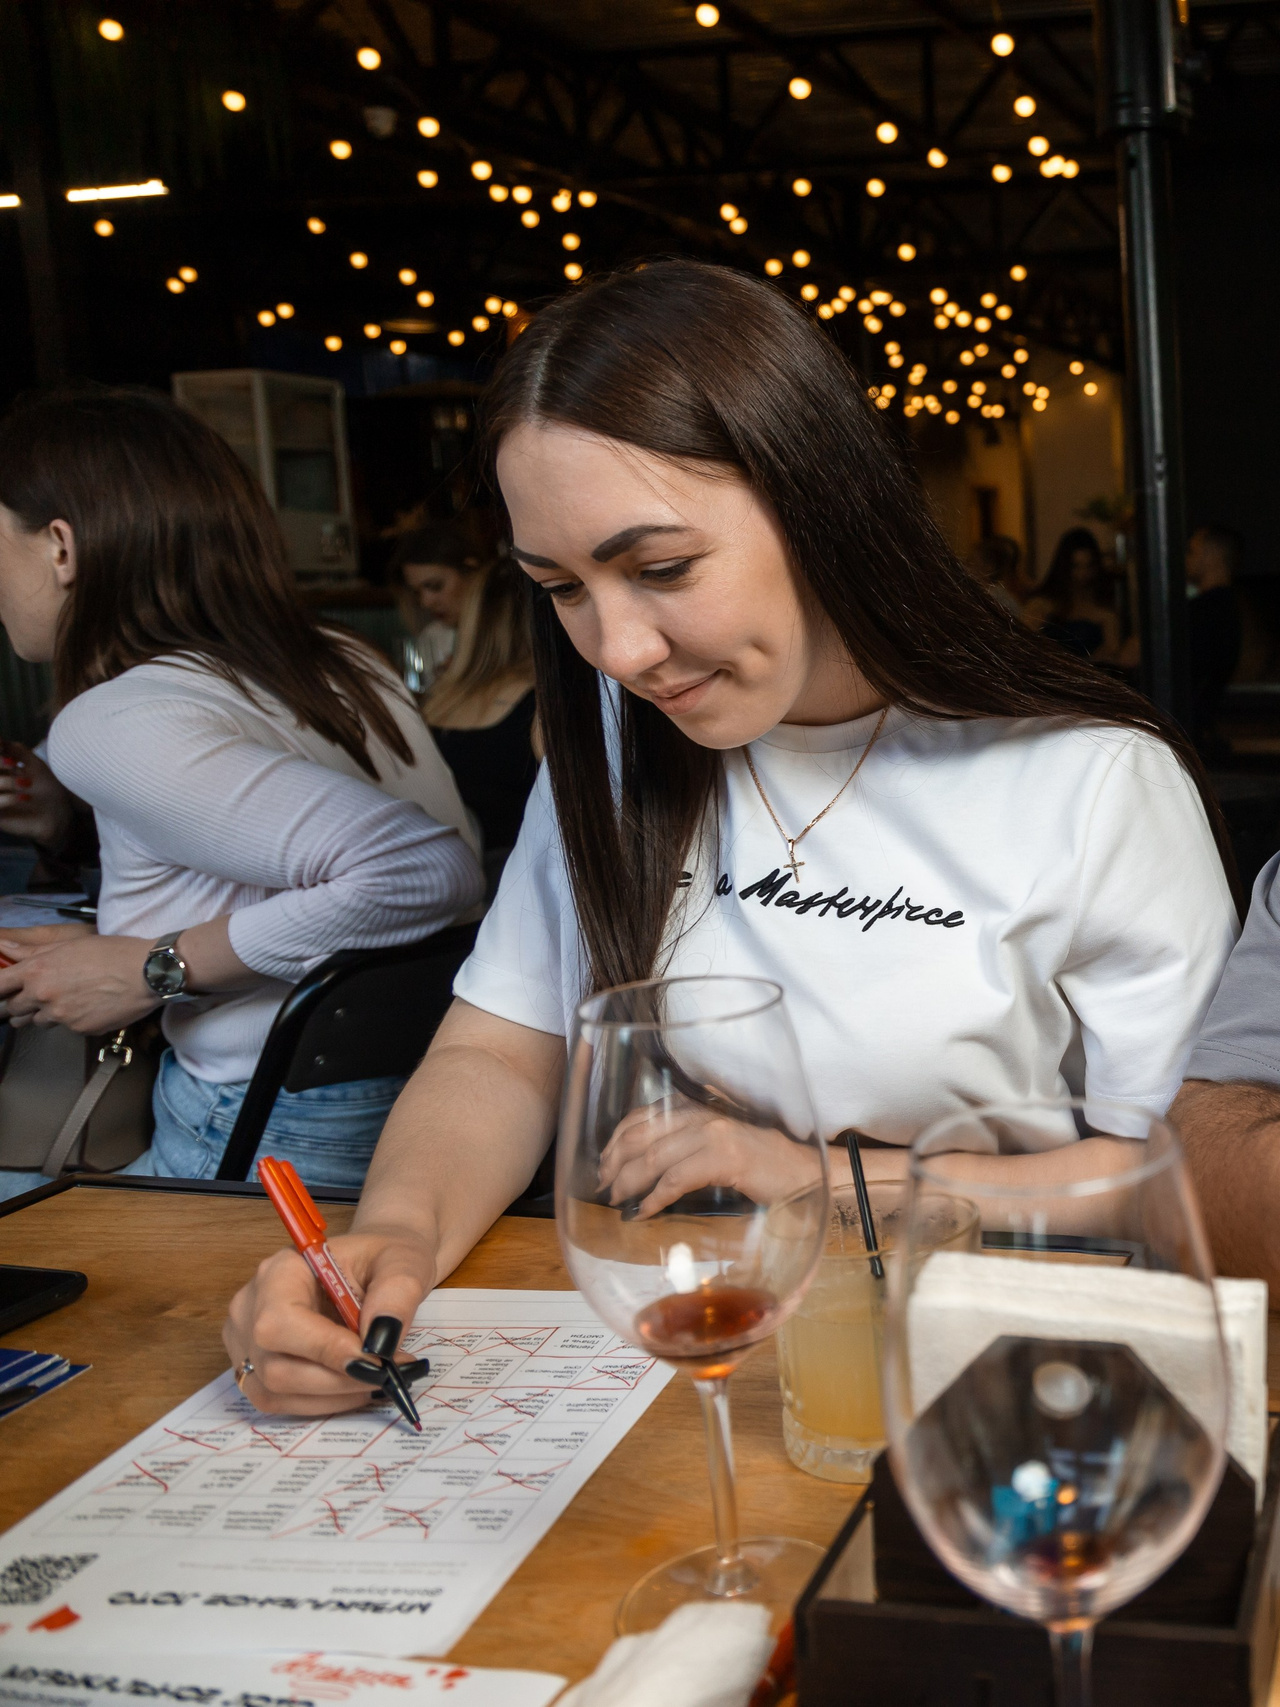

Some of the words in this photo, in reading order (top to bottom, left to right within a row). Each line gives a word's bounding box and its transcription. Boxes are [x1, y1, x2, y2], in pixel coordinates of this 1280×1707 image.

[716, 872, 733, 898] a
[738, 868, 966, 932] Masterpiece
[108, 1590, 200, 1606] ЛОТО
[202, 1594, 432, 1614] МУЗЫКАЛЬНОЕ
